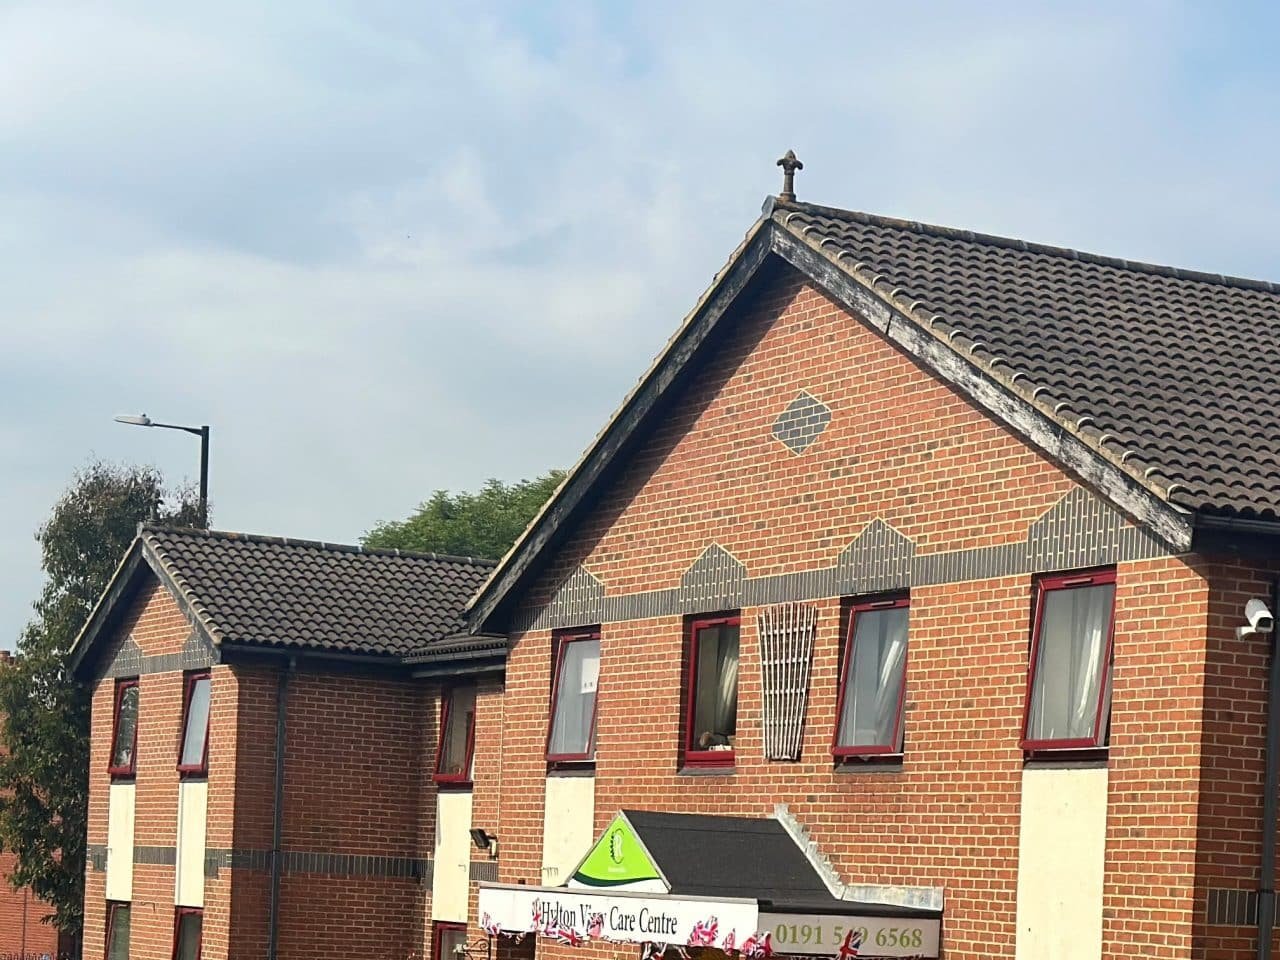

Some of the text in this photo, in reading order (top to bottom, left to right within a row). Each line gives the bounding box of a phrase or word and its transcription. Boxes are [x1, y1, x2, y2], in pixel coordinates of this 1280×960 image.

[541, 901, 576, 928] Hylton
[610, 906, 636, 931] Care
[639, 907, 678, 935] Centre
[775, 923, 923, 948] 0191 59 6568
